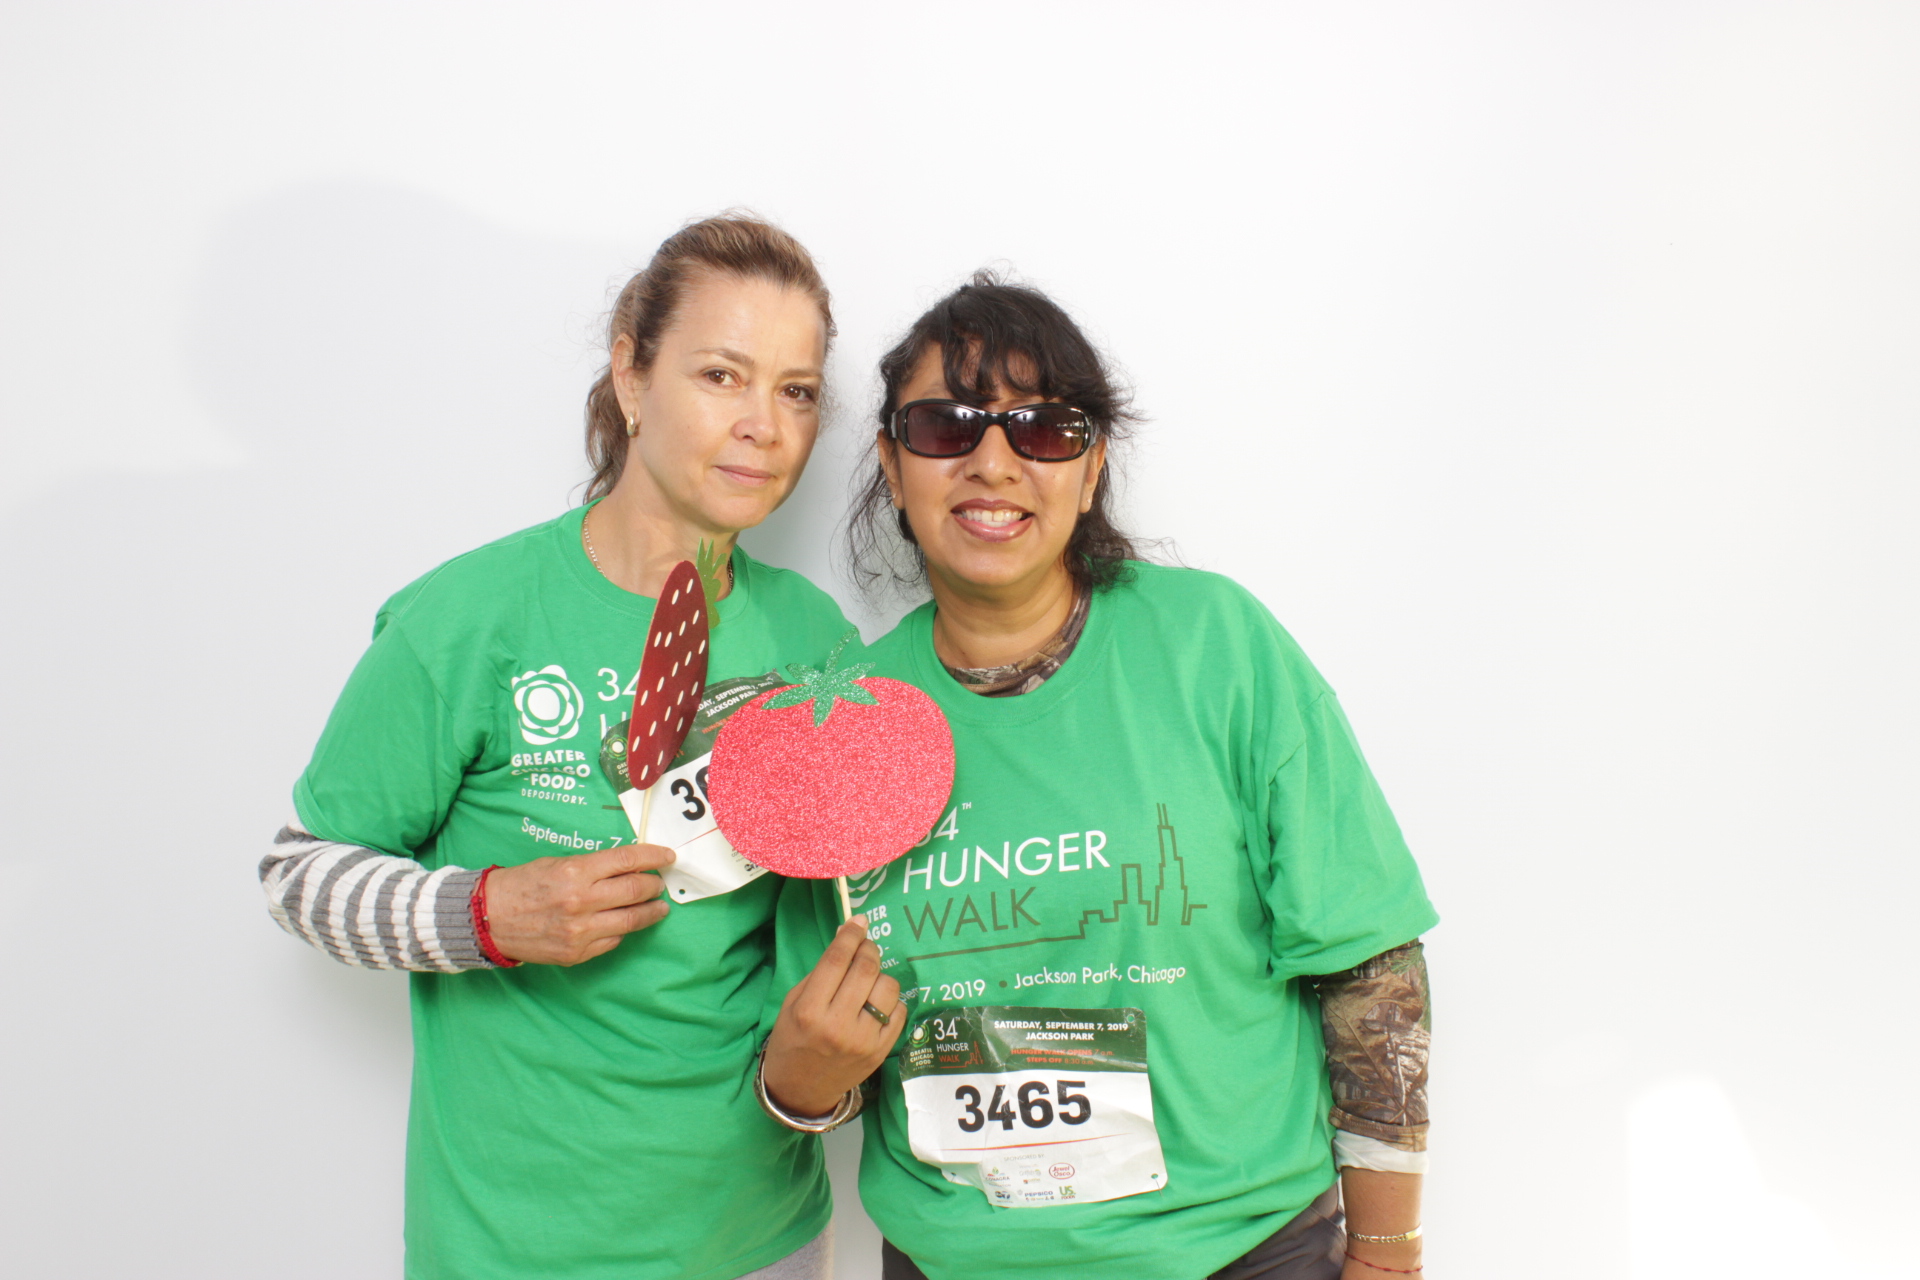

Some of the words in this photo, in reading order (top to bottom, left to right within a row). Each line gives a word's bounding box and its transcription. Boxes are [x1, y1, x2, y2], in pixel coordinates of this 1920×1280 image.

[706, 696, 740, 718] JACKSON
[511, 749, 585, 767] GREATER
[521, 816, 603, 851] September
[903, 830, 1110, 894] HUNGER
[903, 887, 1041, 942] WALK
[919, 986, 936, 1004] 7,
[941, 979, 986, 1001] 2019
[1013, 966, 1076, 989] Jackson
[1082, 963, 1122, 983] Park,
[1127, 965, 1186, 985] Chicago
[994, 1020, 1043, 1030] SATURDAY,
[1045, 1021, 1095, 1030] SEPTEMBER
[1096, 1022, 1104, 1032] 7,
[1107, 1023, 1129, 1031] 2019
[1025, 1032, 1068, 1040] JACKSON
[1070, 1032, 1095, 1041] PARK
[936, 1042, 969, 1053] HUNGER
[1011, 1048, 1042, 1056] HUNGER
[939, 1054, 960, 1063] WALK
[955, 1080, 1092, 1132] 3465
